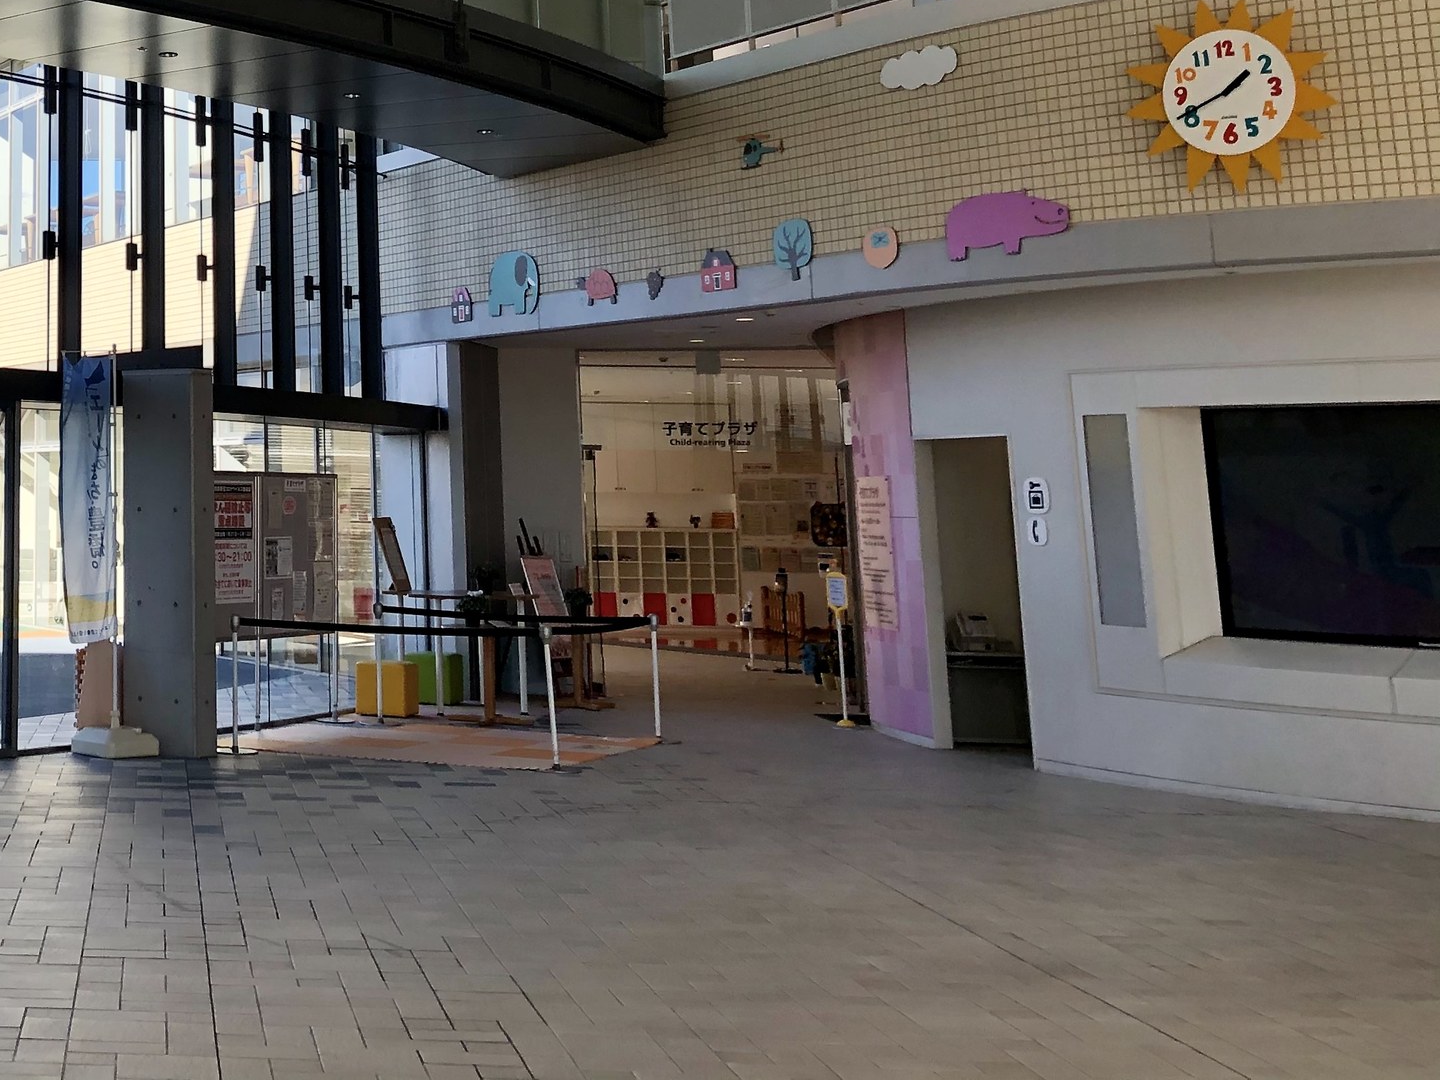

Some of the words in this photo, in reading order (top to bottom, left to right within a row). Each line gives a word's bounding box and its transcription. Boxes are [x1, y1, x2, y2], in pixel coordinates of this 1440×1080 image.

[1191, 49, 1210, 67] 11
[1213, 40, 1235, 58] 12
[1241, 42, 1251, 62] 1
[1257, 54, 1272, 74] 2
[1174, 67, 1197, 84] 10
[1174, 86, 1188, 106] 9
[1267, 76, 1282, 96] 3
[1184, 104, 1200, 128] 8
[1262, 100, 1277, 120] 4
[1202, 120, 1219, 141] 7
[1222, 122, 1239, 144] 6
[1244, 116, 1259, 137] 5
[662, 421, 758, 436] 子育てプラザ
[669, 438, 726, 448] Child-rearing
[728, 438, 751, 446] Plaza
